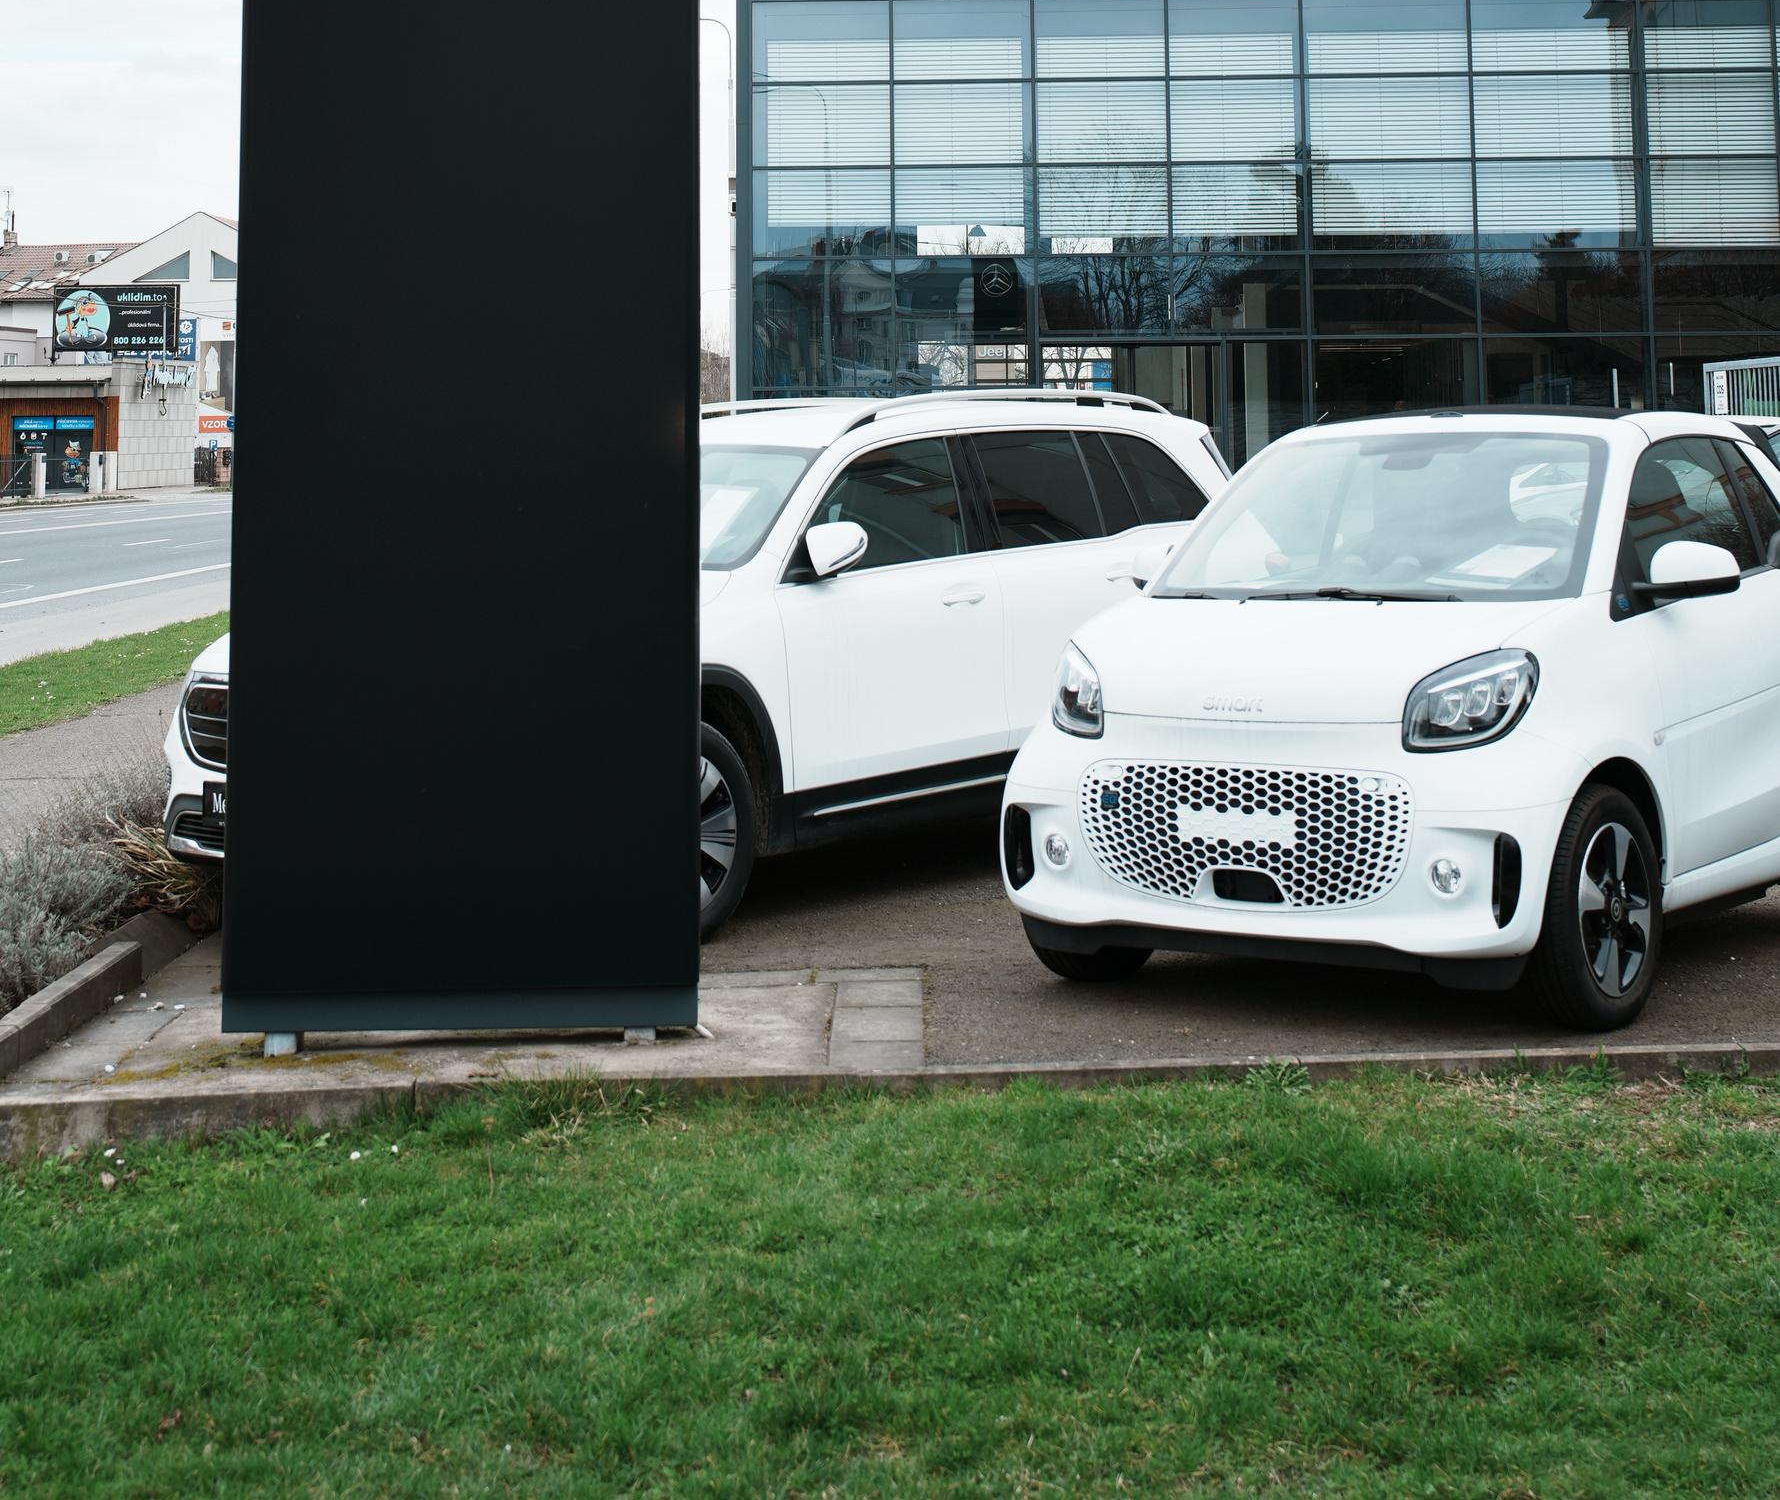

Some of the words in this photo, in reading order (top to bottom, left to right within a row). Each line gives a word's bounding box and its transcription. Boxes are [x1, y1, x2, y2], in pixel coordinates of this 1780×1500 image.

[113, 336, 129, 345] 800
[131, 336, 147, 345] 226
[148, 336, 164, 345] 226
[978, 345, 1011, 359] Jeep
[201, 420, 227, 429] VZOR
[210, 440, 217, 448] P
[1203, 696, 1263, 712] smart
